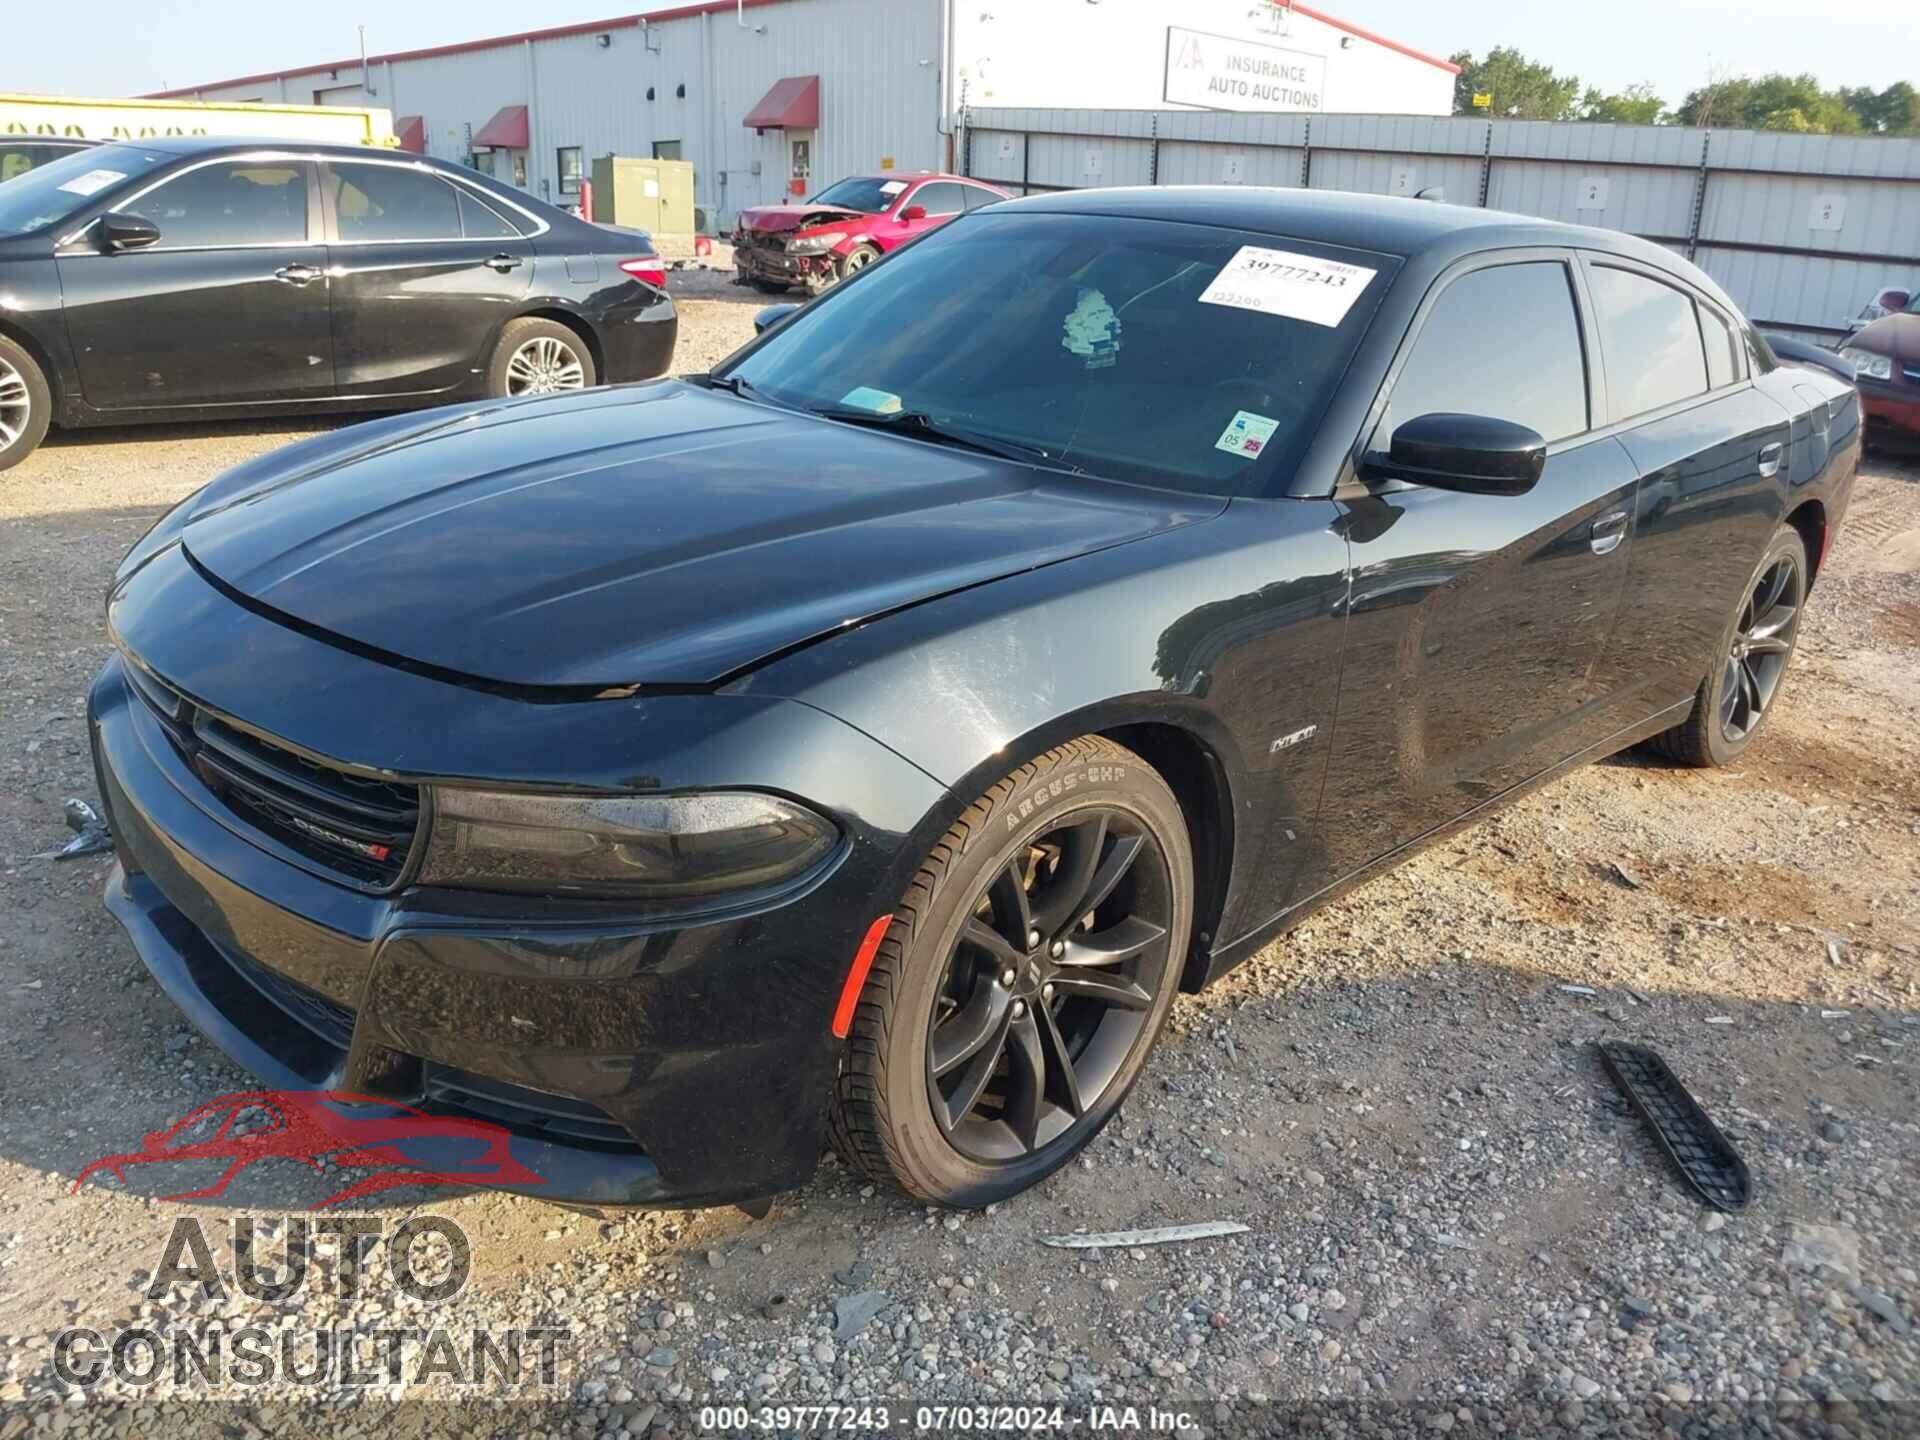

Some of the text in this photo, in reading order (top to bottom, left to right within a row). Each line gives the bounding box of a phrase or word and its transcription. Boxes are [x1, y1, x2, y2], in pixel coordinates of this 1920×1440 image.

[1225, 54, 1307, 83] INSURANCE
[1208, 75, 1320, 109] AUTO AUCTIONS
[1241, 258, 1347, 287] 39777243
